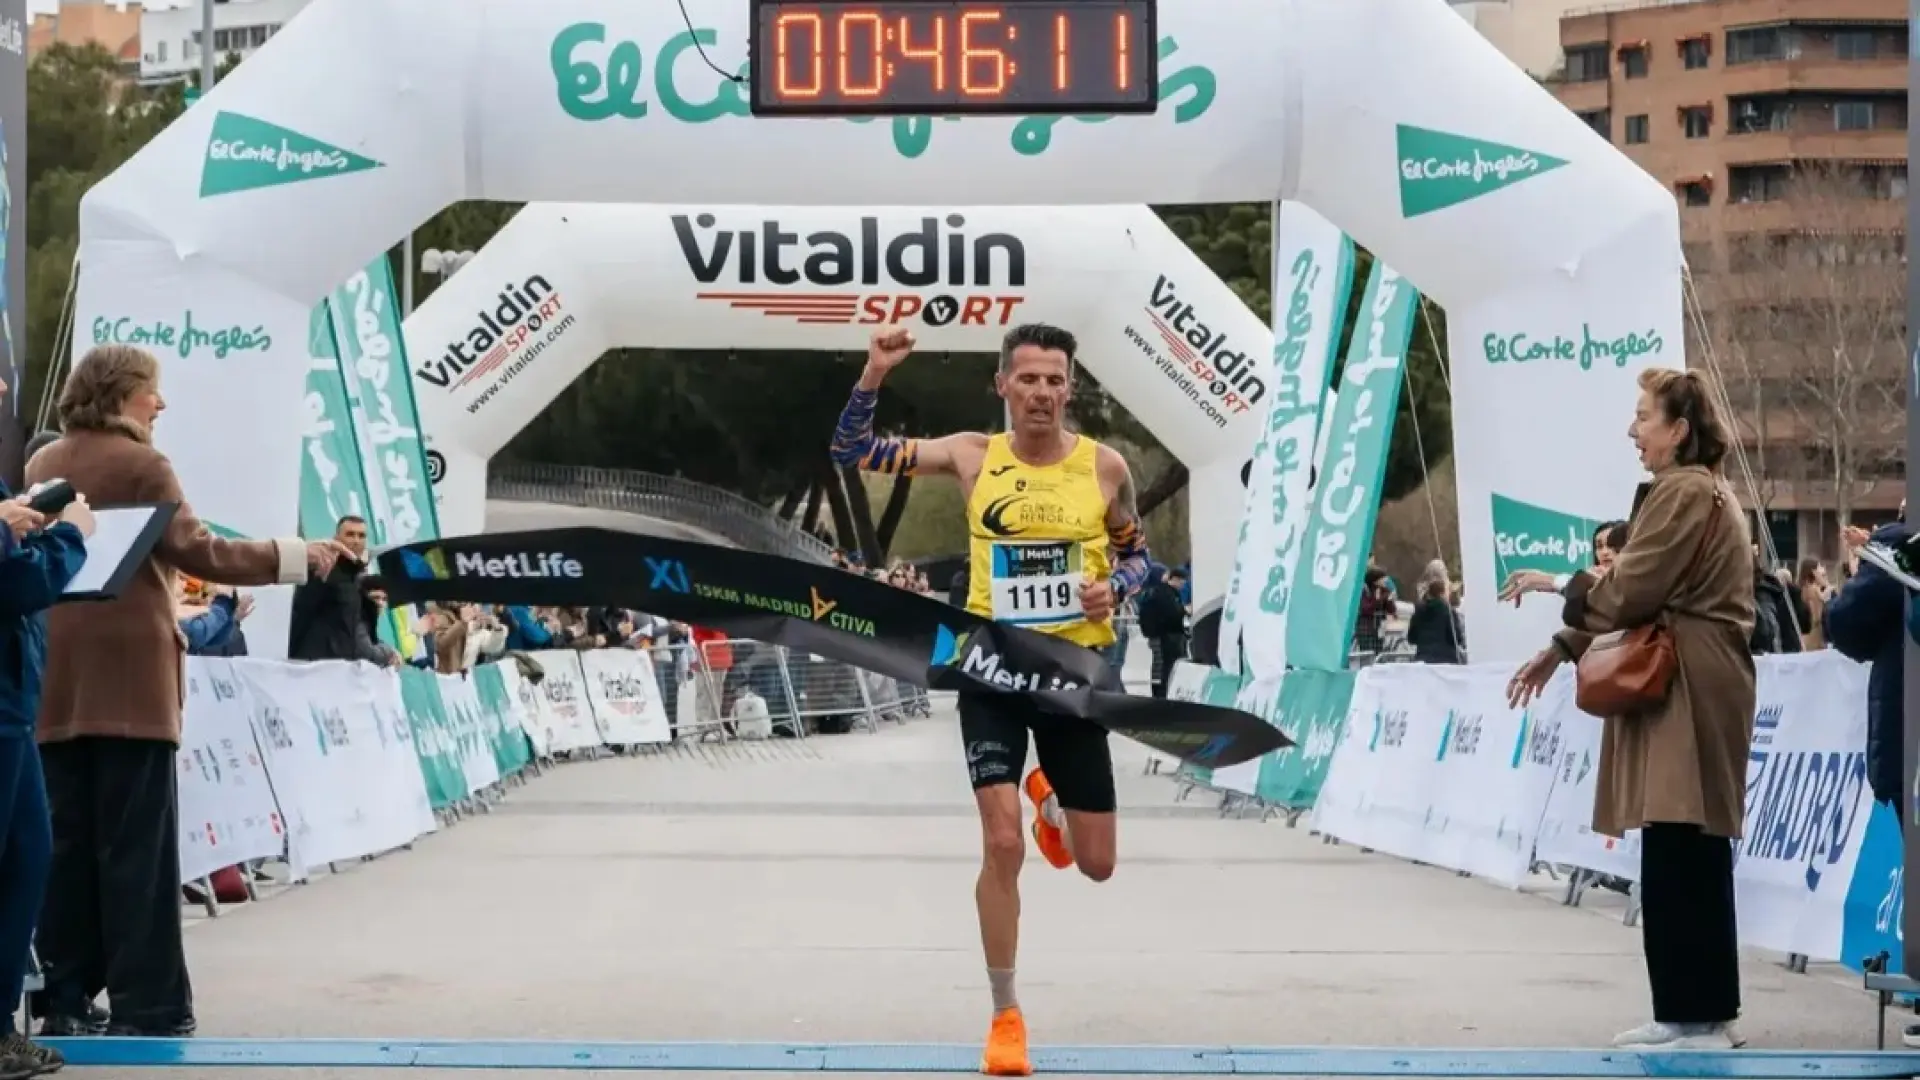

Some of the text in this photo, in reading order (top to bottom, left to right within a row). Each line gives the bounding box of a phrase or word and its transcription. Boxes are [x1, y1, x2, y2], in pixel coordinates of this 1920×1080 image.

[551, 22, 647, 121] El
[230, 140, 276, 164] Corte
[1402, 158, 1422, 179] El
[1424, 158, 1471, 178] Corte
[670, 212, 1025, 286] Vitaldin
[93, 315, 112, 344] El
[114, 316, 175, 346] Corte
[415, 274, 554, 387] Vitaldin
[1149, 273, 1266, 405] Vitaldin
[466, 313, 576, 414] www.vitaldin.com
[1483, 333, 1508, 363] El
[1509, 333, 1575, 362] Corte
[1124, 324, 1228, 429] www.vitaldin.com
[1496, 532, 1515, 556] El
[1516, 533, 1564, 556] Corte
[455, 552, 584, 578] MetLife
[644, 556, 691, 594] XI
[744, 593, 811, 619] MADRID
[1007, 581, 1071, 611] 1119
